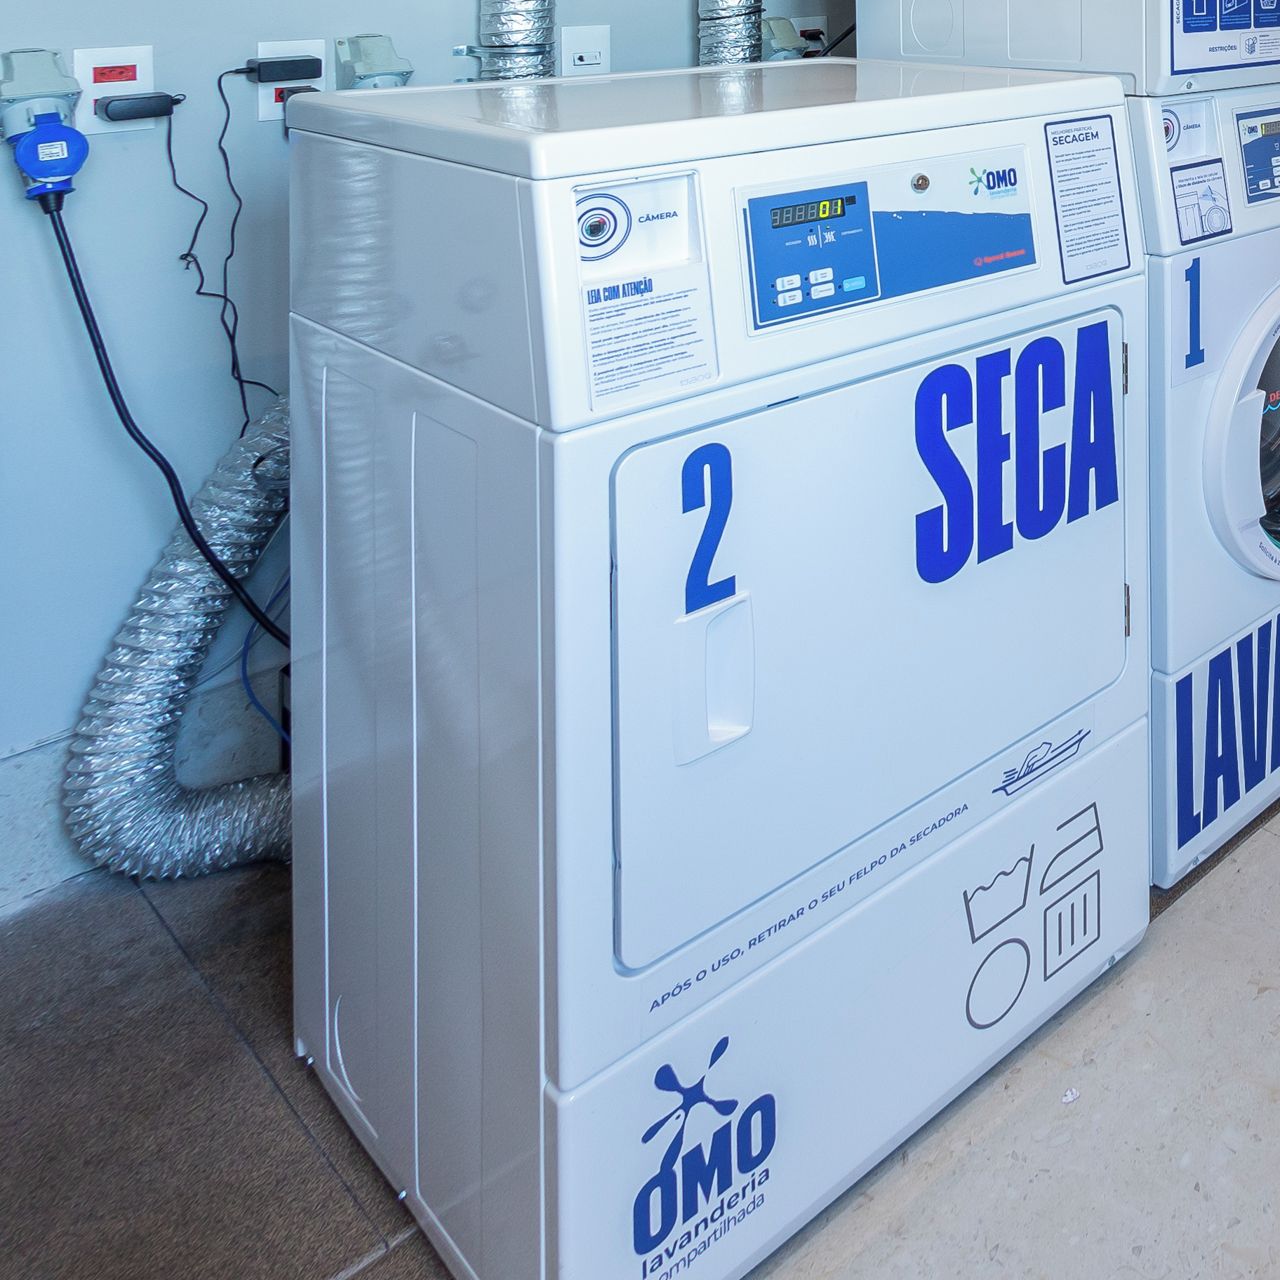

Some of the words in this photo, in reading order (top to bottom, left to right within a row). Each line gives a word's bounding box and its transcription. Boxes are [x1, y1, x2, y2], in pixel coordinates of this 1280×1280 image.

[986, 168, 1017, 190] OMO
[1052, 131, 1099, 146] SECAGEM
[638, 210, 678, 223] CÂMERA
[820, 199, 841, 218] 01
[587, 288, 602, 305] LEIA
[603, 284, 620, 302] COM
[1185, 257, 1205, 369] 1
[915, 320, 1119, 584] SECA
[682, 443, 736, 614] 2
[649, 978, 692, 1013] APÓS
[696, 969, 707, 982] O
[711, 948, 744, 972] USO,
[748, 907, 805, 950] RETIRAR
[808, 899, 818, 910] O
[821, 880, 845, 903] SEU
[849, 855, 887, 885] FELPO
[890, 843, 907, 858] DA
[909, 803, 968, 846] SECADORA
[634, 1094, 776, 1255] OMO
[642, 1168, 770, 1280] lavanderia
[659, 1193, 764, 1280] ompartilhada
